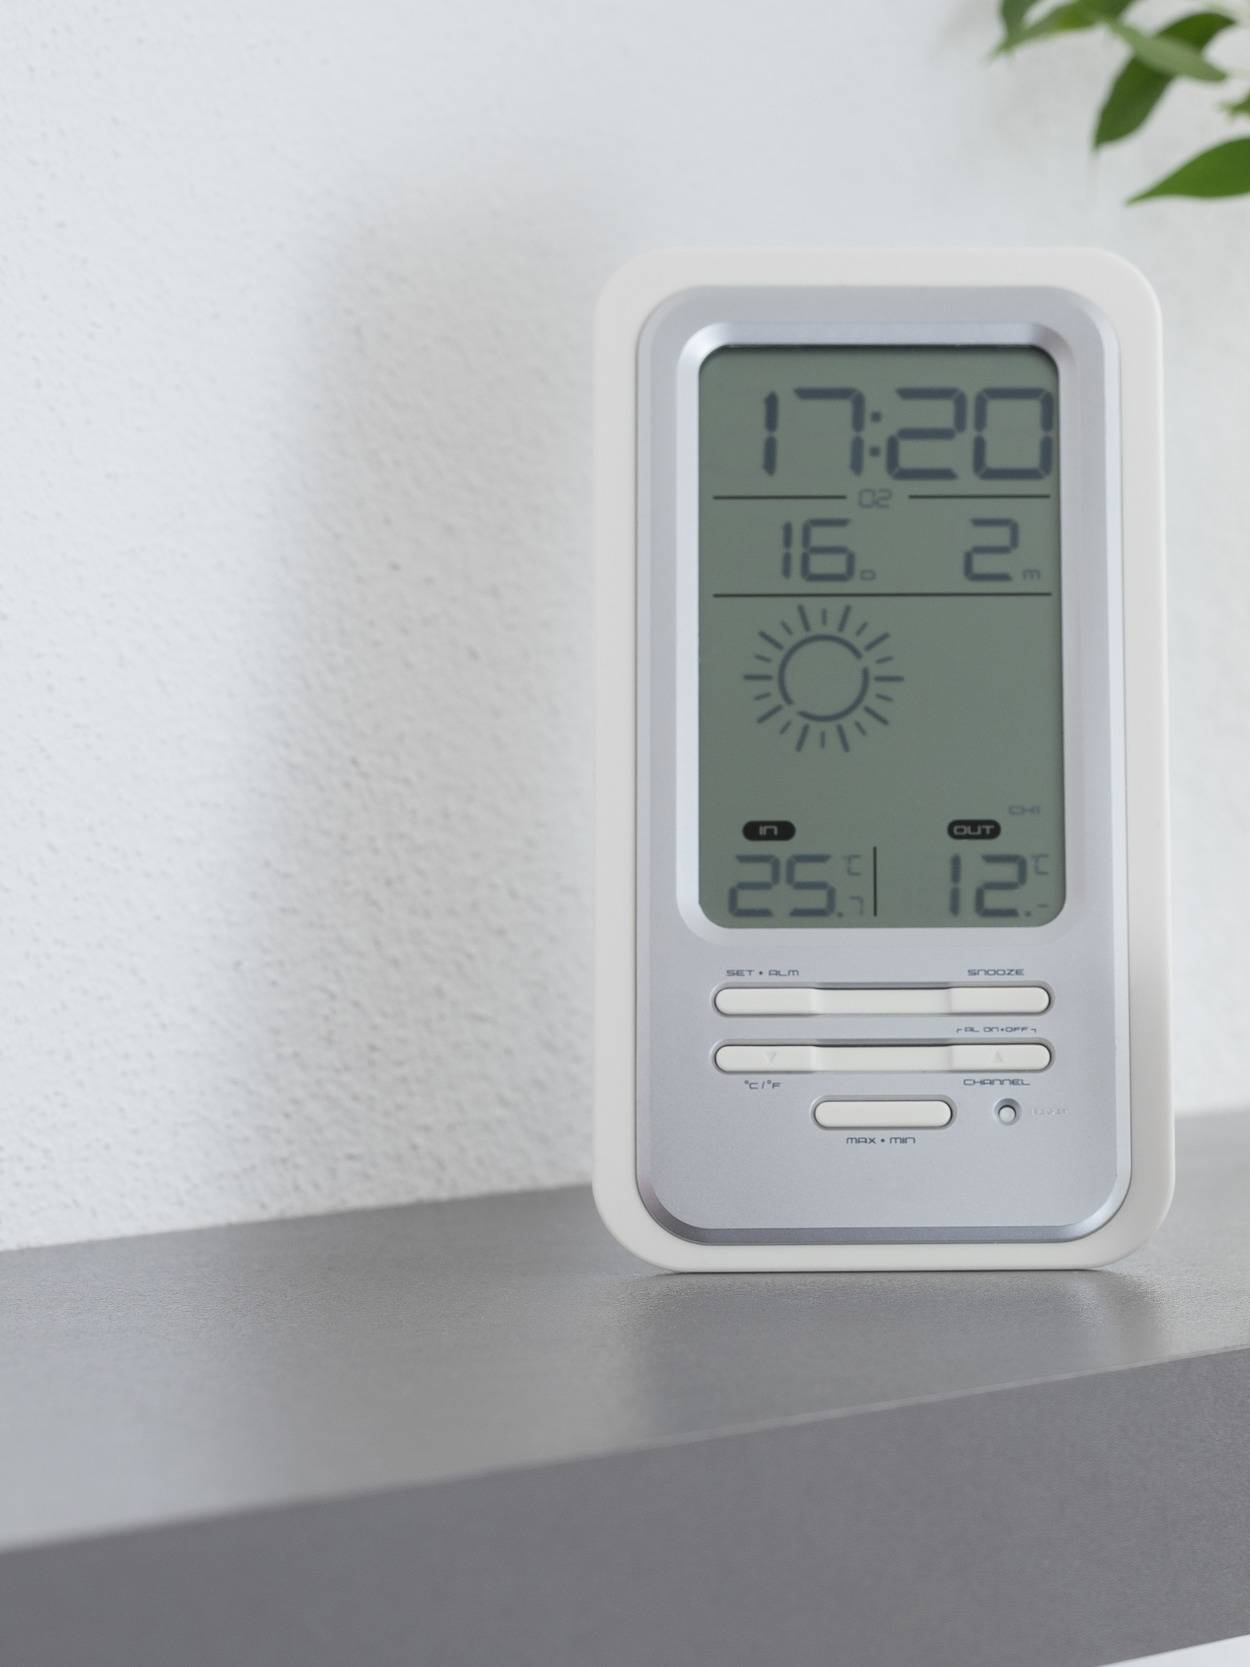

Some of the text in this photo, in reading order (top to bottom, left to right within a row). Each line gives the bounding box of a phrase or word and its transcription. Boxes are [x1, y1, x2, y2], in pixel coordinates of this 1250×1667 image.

[763, 387, 1053, 481] 17:20
[781, 518, 855, 582] 16
[963, 518, 1019, 582] 2
[953, 825, 995, 836] OUT
[726, 969, 754, 977] SET
[967, 968, 1025, 977] SNOOZE
[963, 1078, 1031, 1086] CHANNEL
[846, 1136, 916, 1145] MAX MIN
